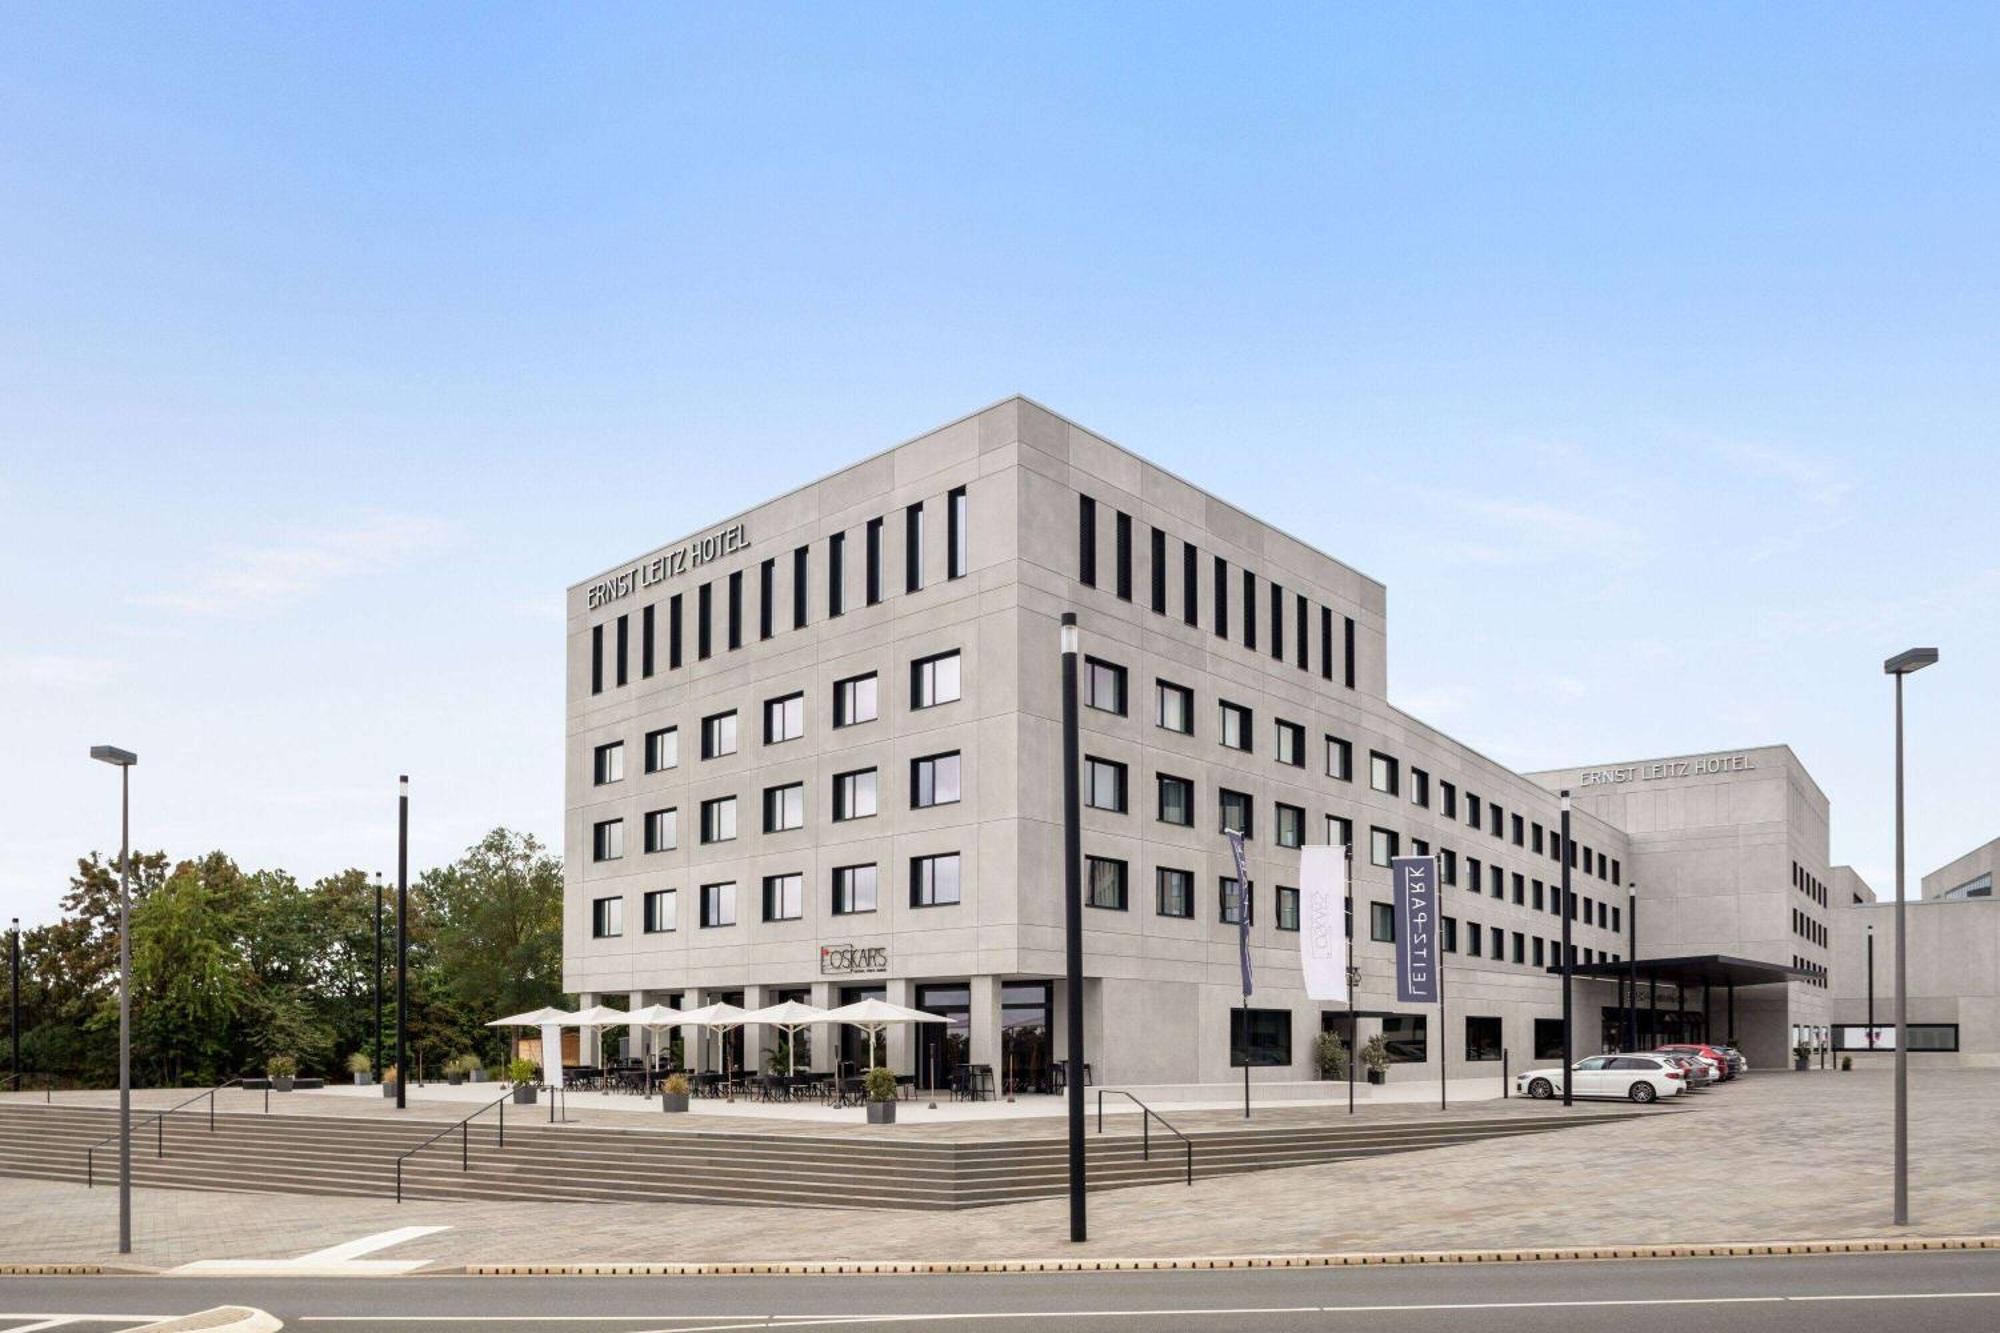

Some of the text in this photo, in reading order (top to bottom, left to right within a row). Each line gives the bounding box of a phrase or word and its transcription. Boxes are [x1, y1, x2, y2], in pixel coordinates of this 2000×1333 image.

[586, 523, 750, 610] ERNST LEITZ HOTEL
[1580, 754, 1755, 787] ERNST LEITZ HOTEL
